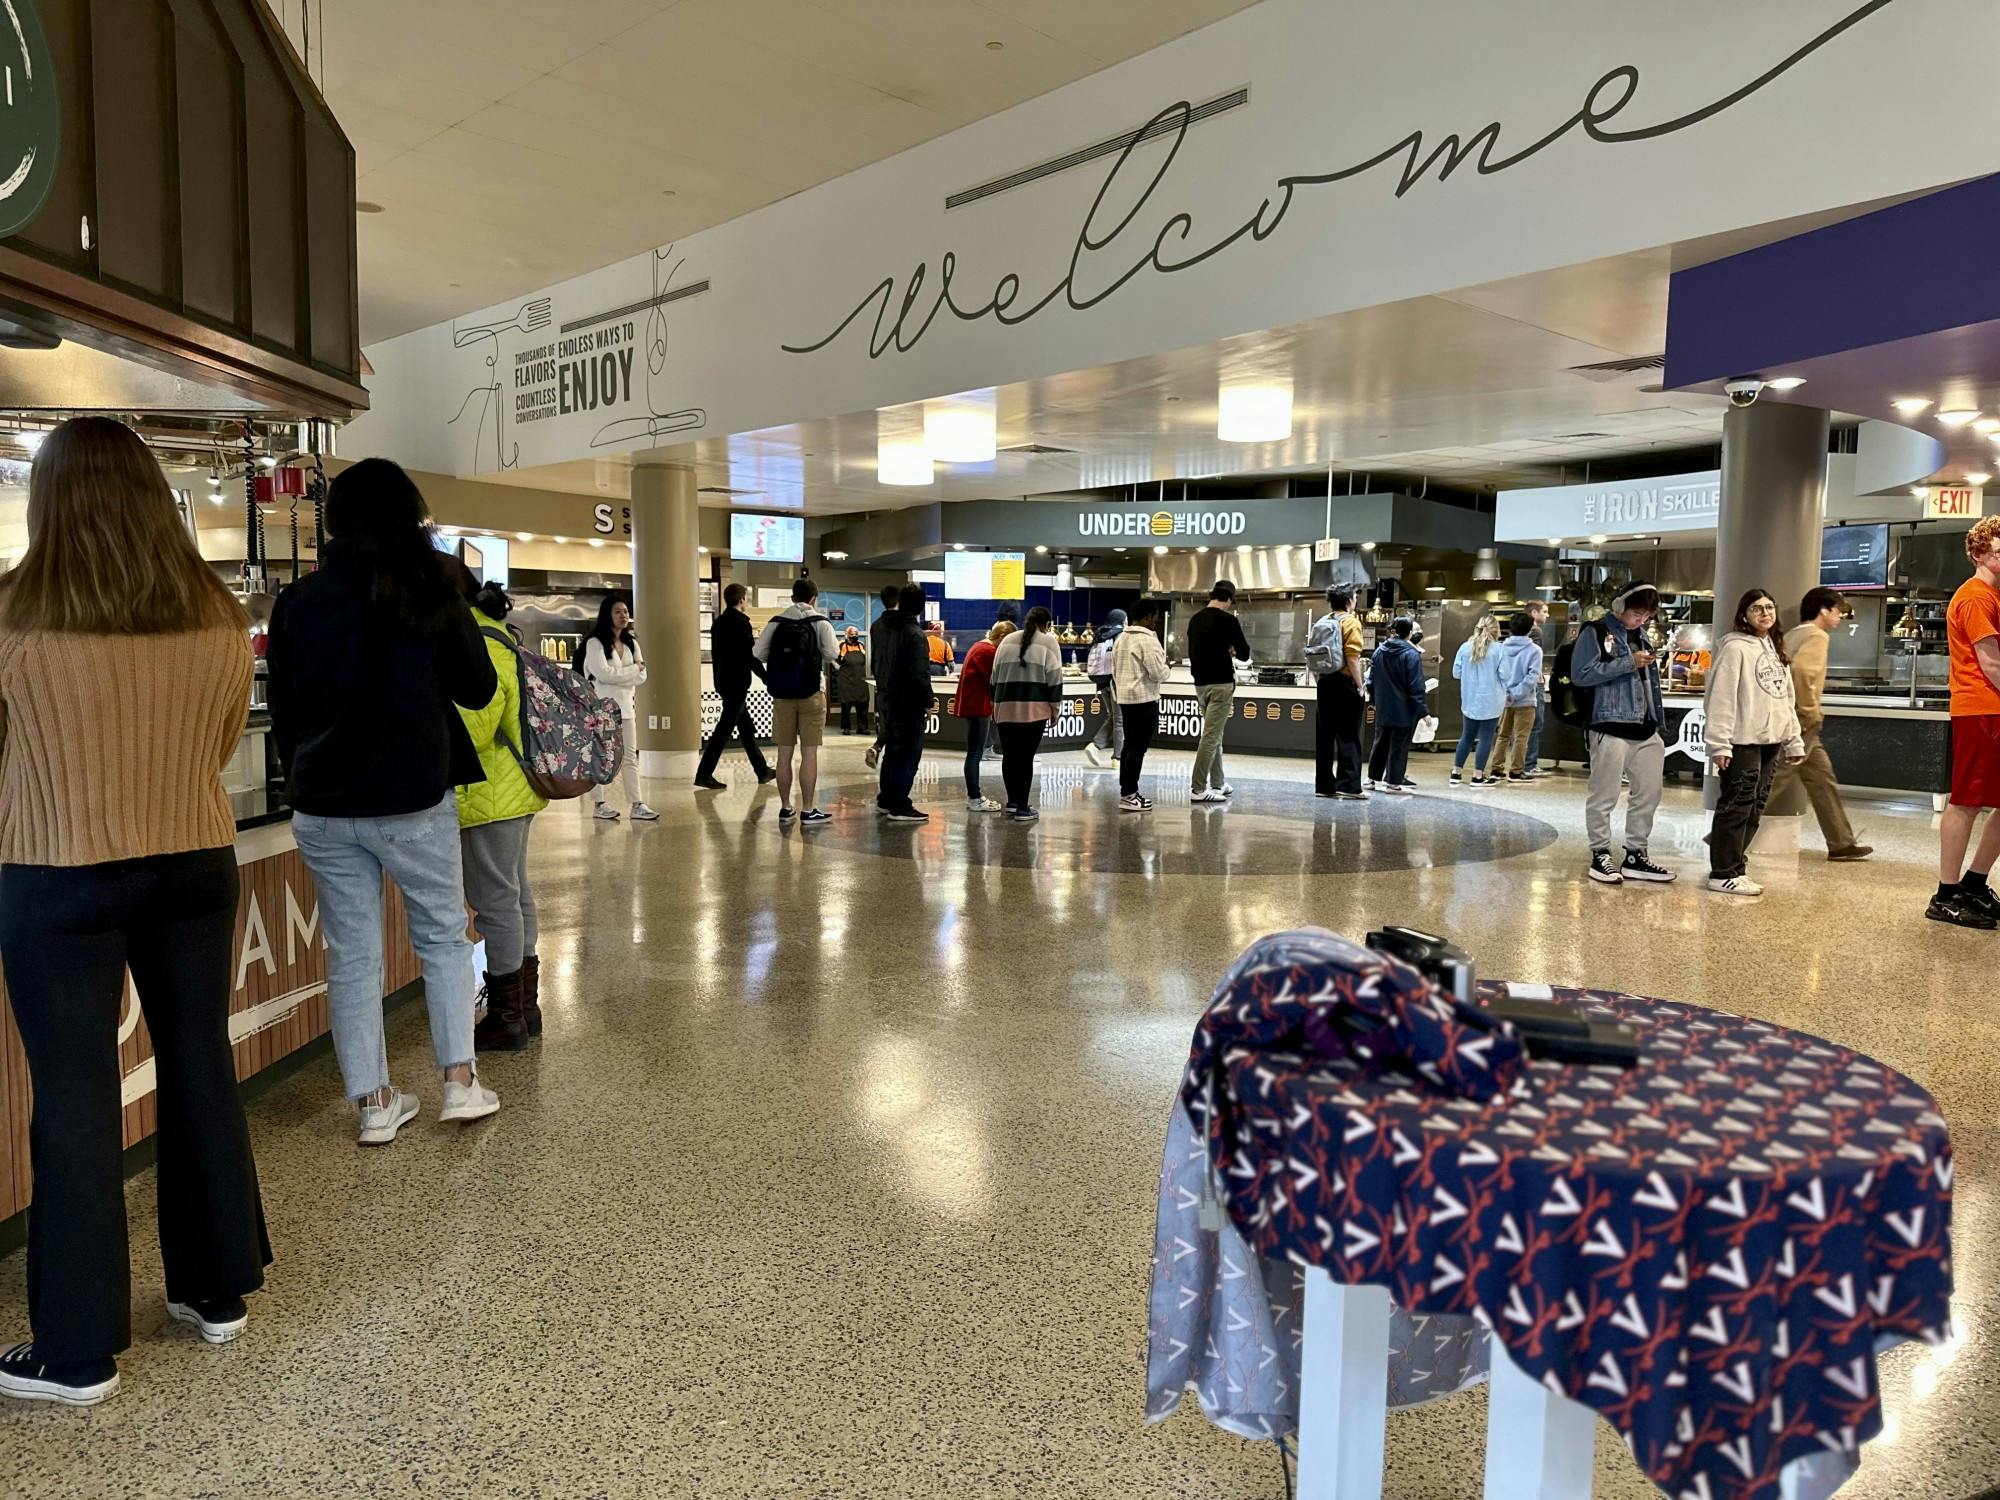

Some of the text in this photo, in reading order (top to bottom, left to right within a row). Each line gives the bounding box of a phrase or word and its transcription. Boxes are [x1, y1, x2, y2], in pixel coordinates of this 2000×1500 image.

[558, 321, 634, 359] ENDLESS WAYS TO
[515, 343, 556, 366] THOUSANDS OF
[515, 359, 556, 388] FLAVORS
[559, 346, 634, 415] ENJOY
[515, 387, 556, 411] COUNTLESS
[515, 406, 557, 424] CONVERSATIONS
[1584, 495, 1596, 524] THE
[1600, 489, 1658, 523] IRON
[1938, 490, 1973, 514] EXIT
[1078, 512, 1246, 536] UNDER THE HOOD
[1848, 623, 1859, 636] 7
[1158, 698, 1199, 716] UNDER
[1157, 714, 1168, 735] THE
